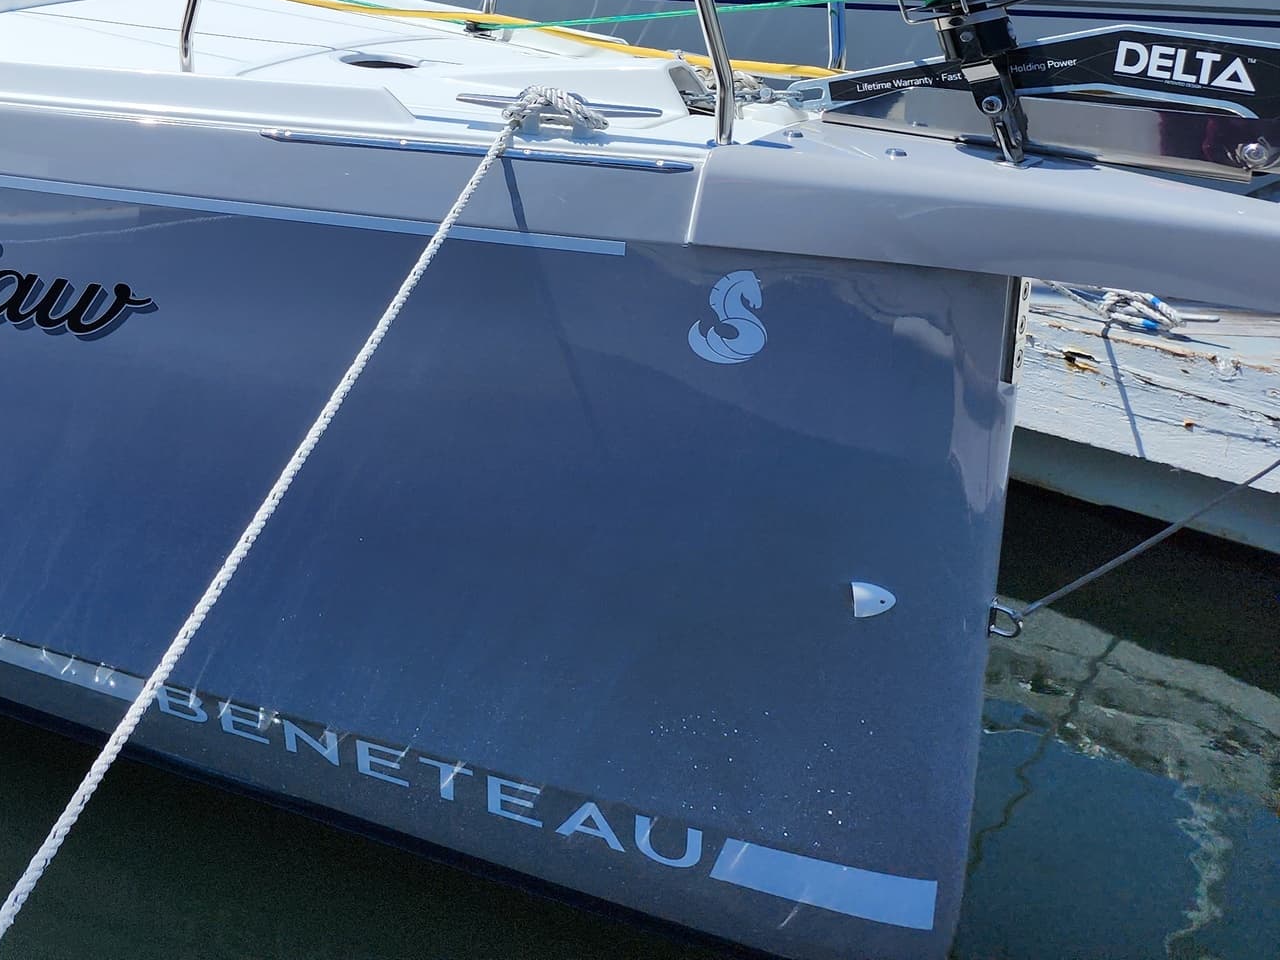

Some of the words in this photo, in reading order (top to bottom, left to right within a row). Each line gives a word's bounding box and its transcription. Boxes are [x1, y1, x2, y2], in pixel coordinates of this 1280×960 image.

[856, 81, 892, 93] Lifetime
[893, 75, 934, 89] Warranty
[941, 72, 963, 82] Fast
[1010, 62, 1047, 74] Holding
[1047, 58, 1078, 70] Power
[1114, 40, 1257, 93] DELTA
[156, 686, 704, 869] BENETEAU
